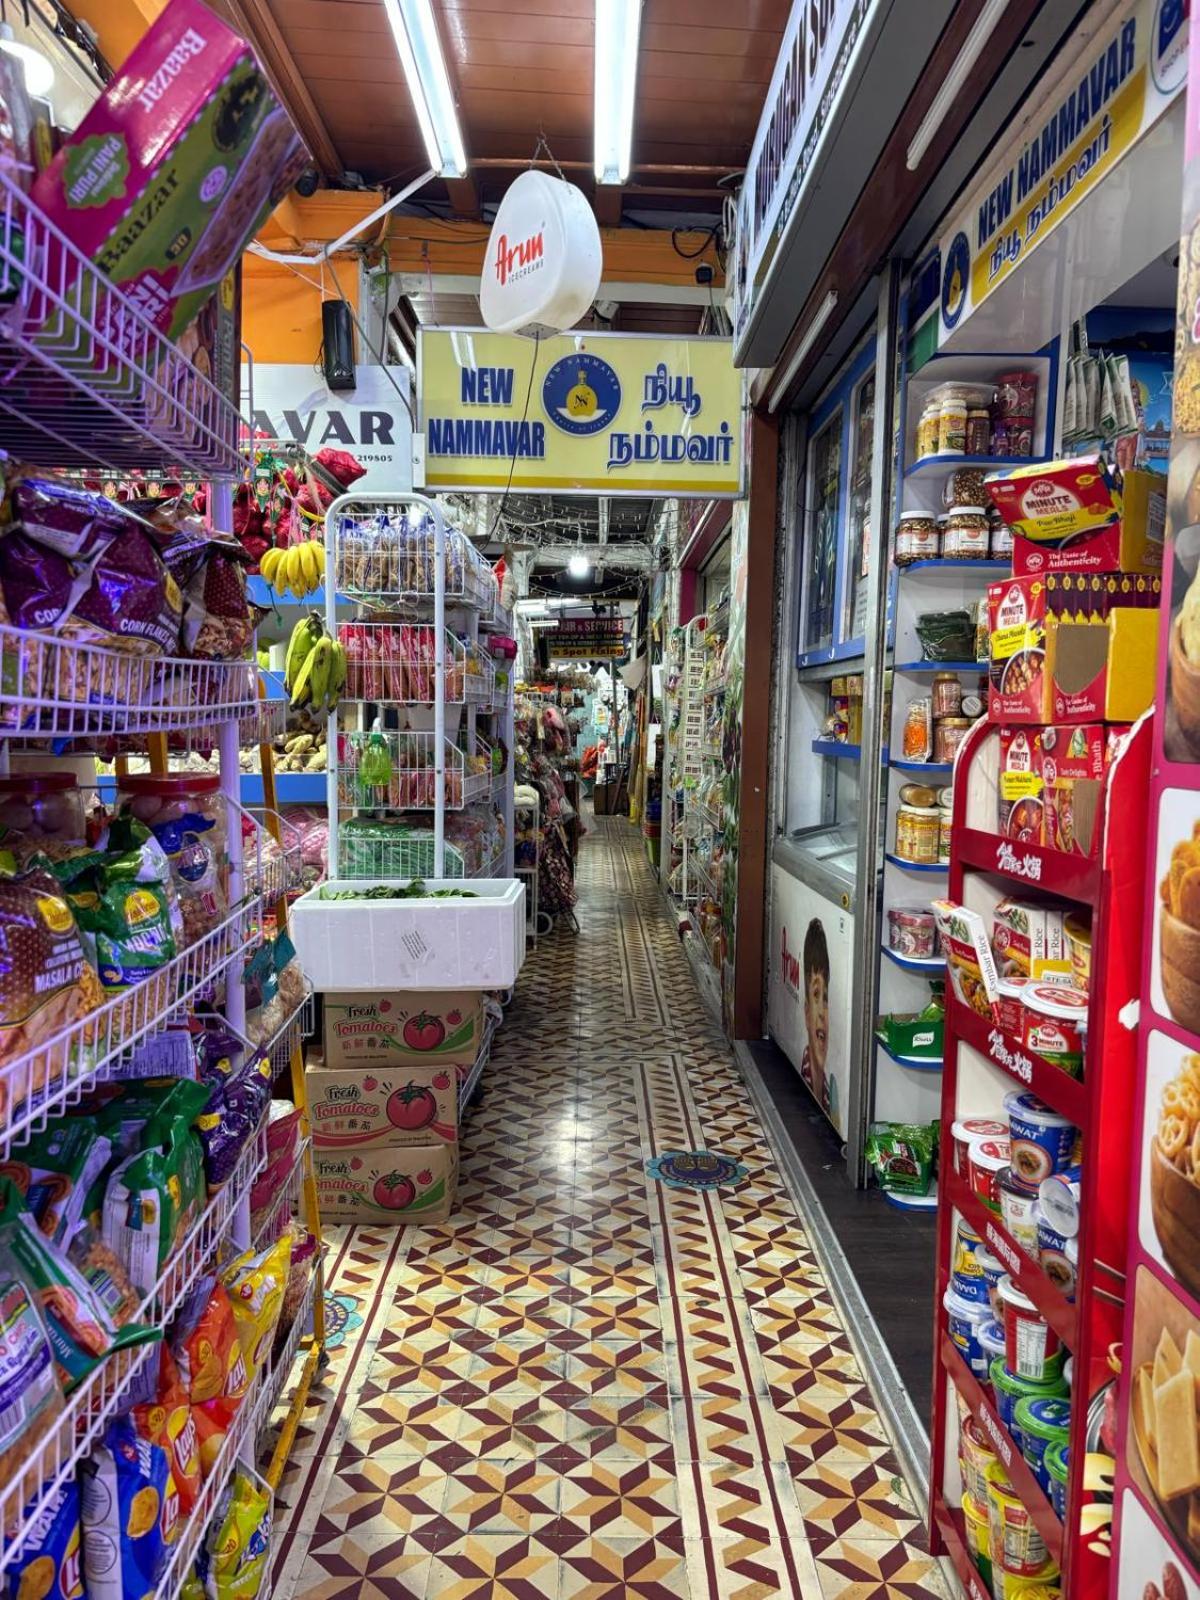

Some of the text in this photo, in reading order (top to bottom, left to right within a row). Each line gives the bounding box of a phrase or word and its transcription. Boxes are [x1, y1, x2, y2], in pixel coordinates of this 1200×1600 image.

[138, 26, 208, 113] Baazar
[977, 17, 1137, 249] NEW NAMMAVAR
[68, 135, 122, 203] PANI PURI
[494, 232, 544, 287] Arun
[461, 367, 514, 405] NEW
[428, 418, 546, 459] NAMMAVAR
[1025, 494, 1072, 510] MINUTE
[1047, 556, 1102, 569] Authenticity
[120, 618, 146, 633] CORN
[143, 622, 168, 644] FLAKES
[335, 1019, 396, 1036] Tomatoes
[328, 1086, 359, 1100] Fresh
[315, 1101, 378, 1119] Tomatoes
[319, 1160, 350, 1175] Fresh
